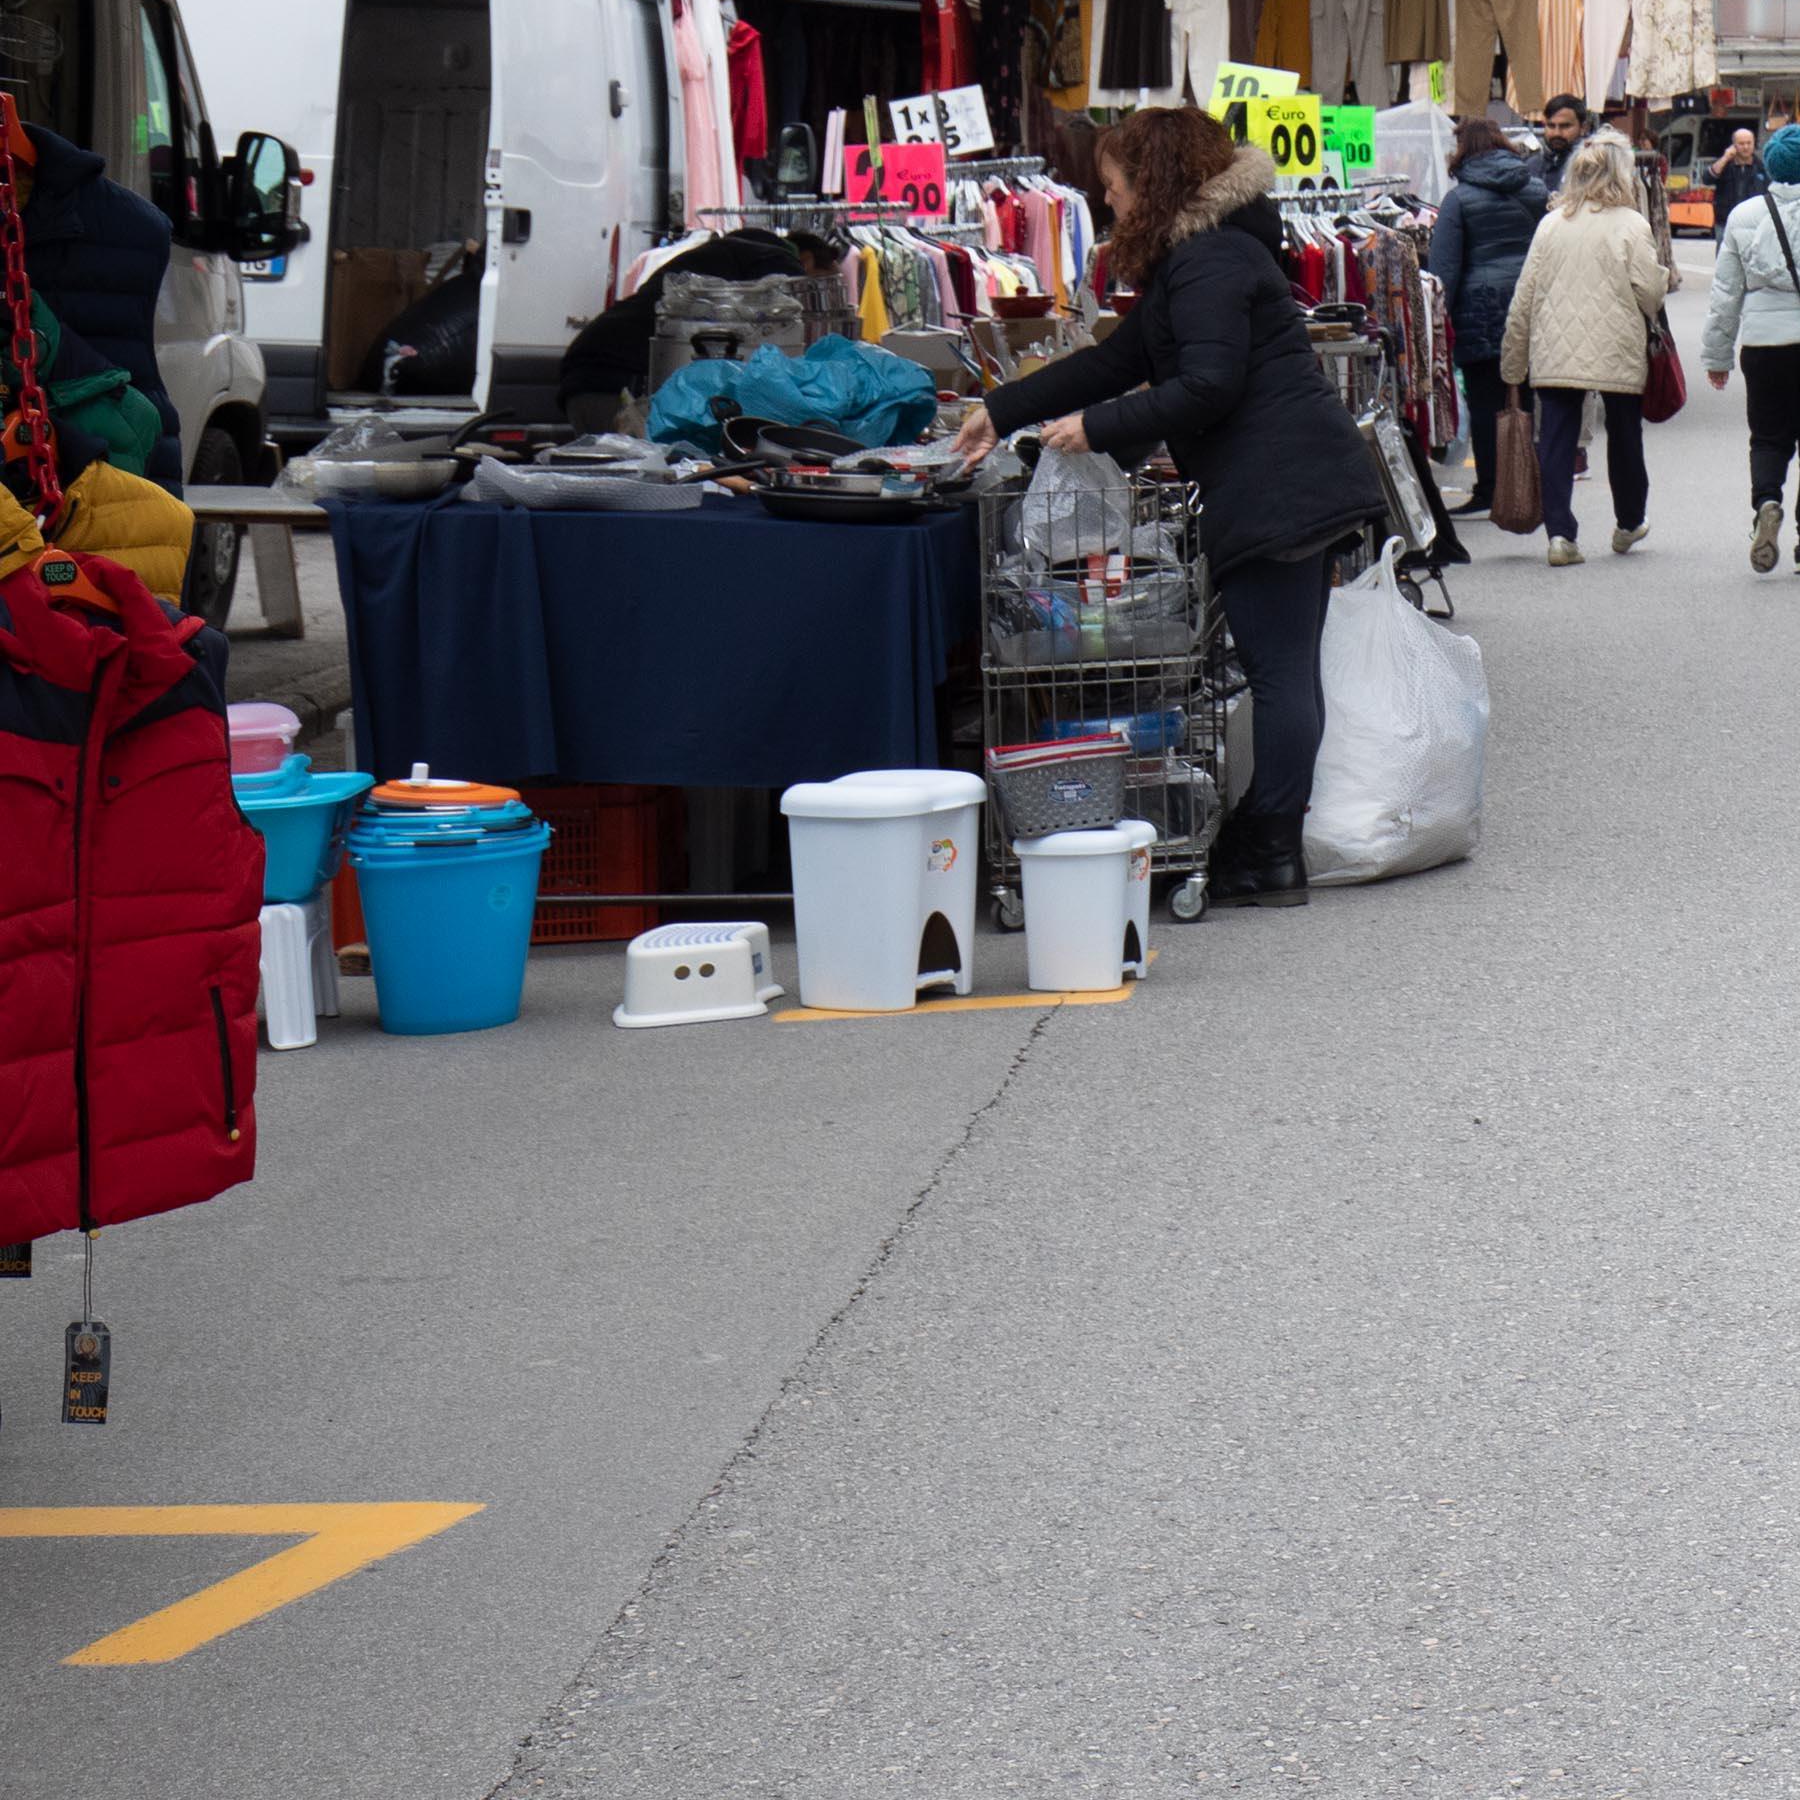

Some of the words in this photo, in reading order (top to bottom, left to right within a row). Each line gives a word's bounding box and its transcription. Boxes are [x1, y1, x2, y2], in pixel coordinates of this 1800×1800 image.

[45, 564, 64, 573] KEEP
[65, 562, 75, 571] IN
[45, 571, 74, 582] TOUCH
[0, 1261, 31, 1272] OUCH
[71, 1371, 103, 1383] KEEP
[69, 1389, 81, 1400] IN
[69, 1406, 107, 1418] TOUCH
